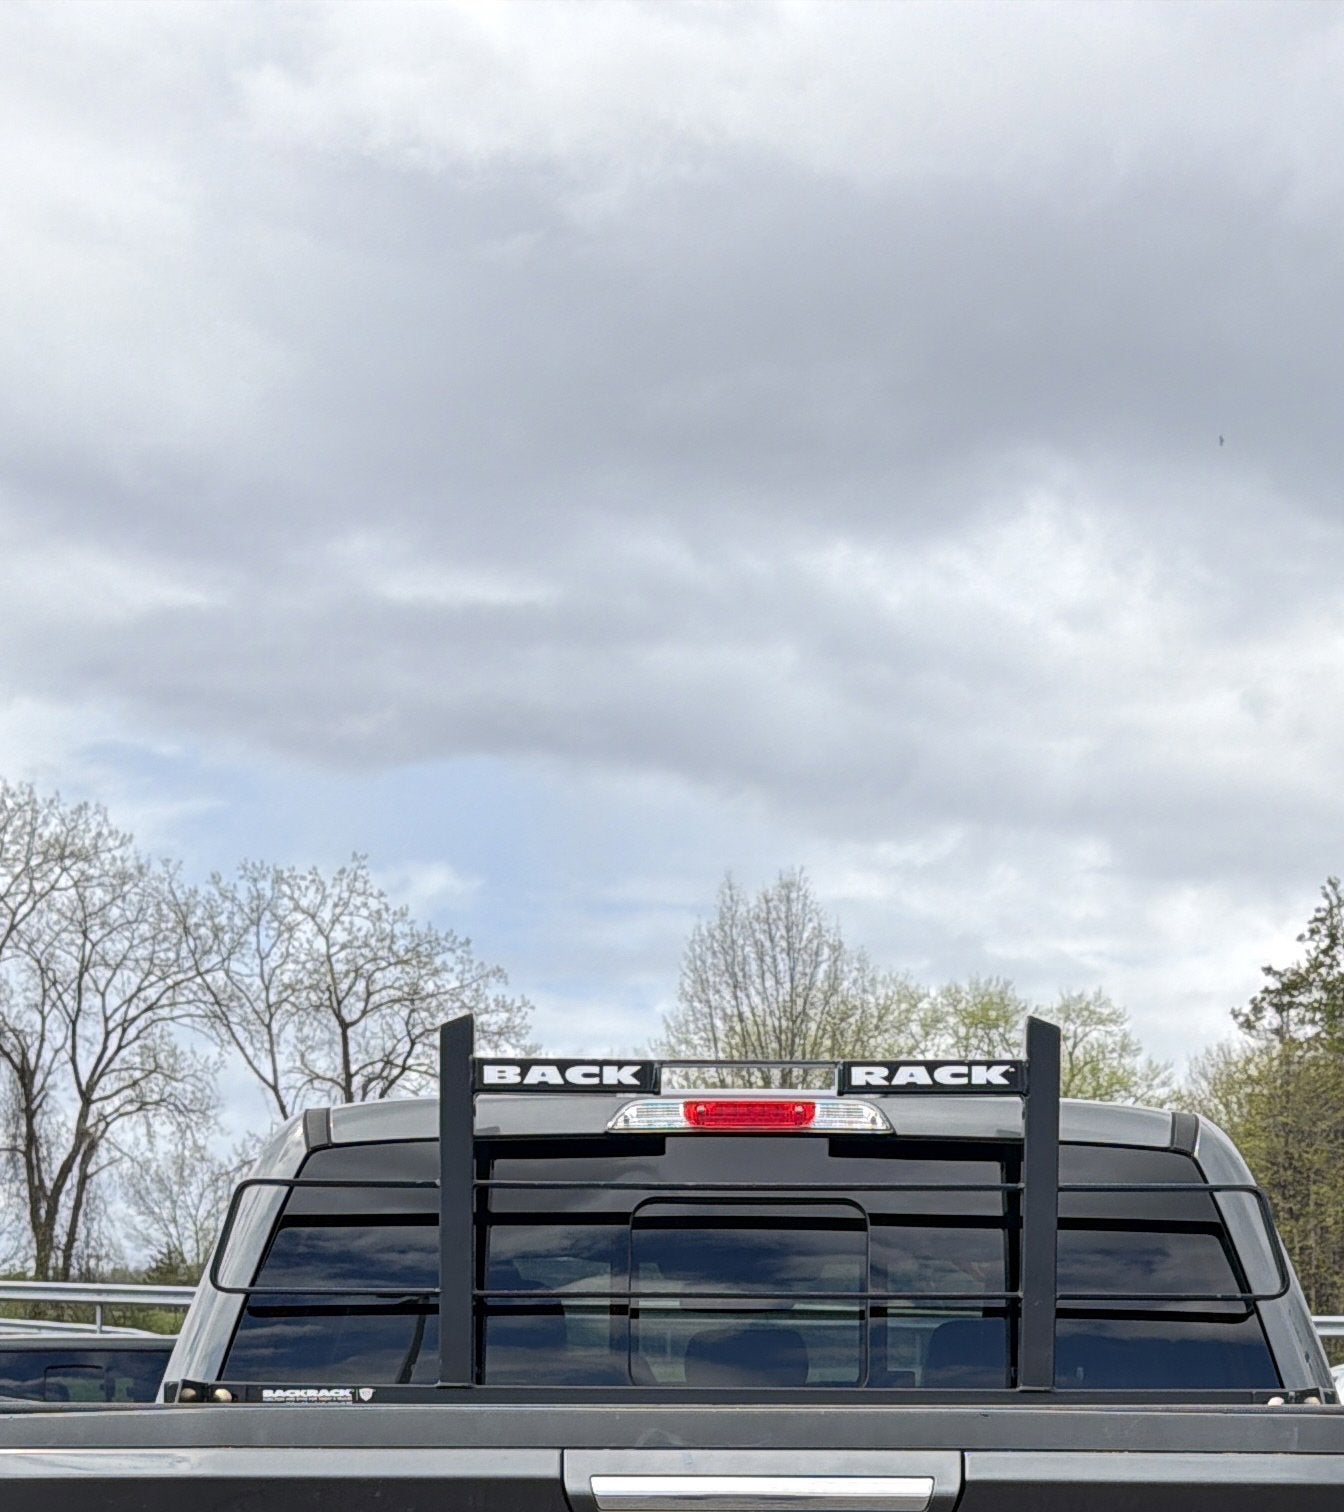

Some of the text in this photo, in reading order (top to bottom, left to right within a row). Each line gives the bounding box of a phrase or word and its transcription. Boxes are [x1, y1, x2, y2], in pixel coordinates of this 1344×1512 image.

[483, 1065, 641, 1085] BACK
[851, 1065, 1011, 1086] RACK
[262, 1389, 353, 1398] BACKRACK
